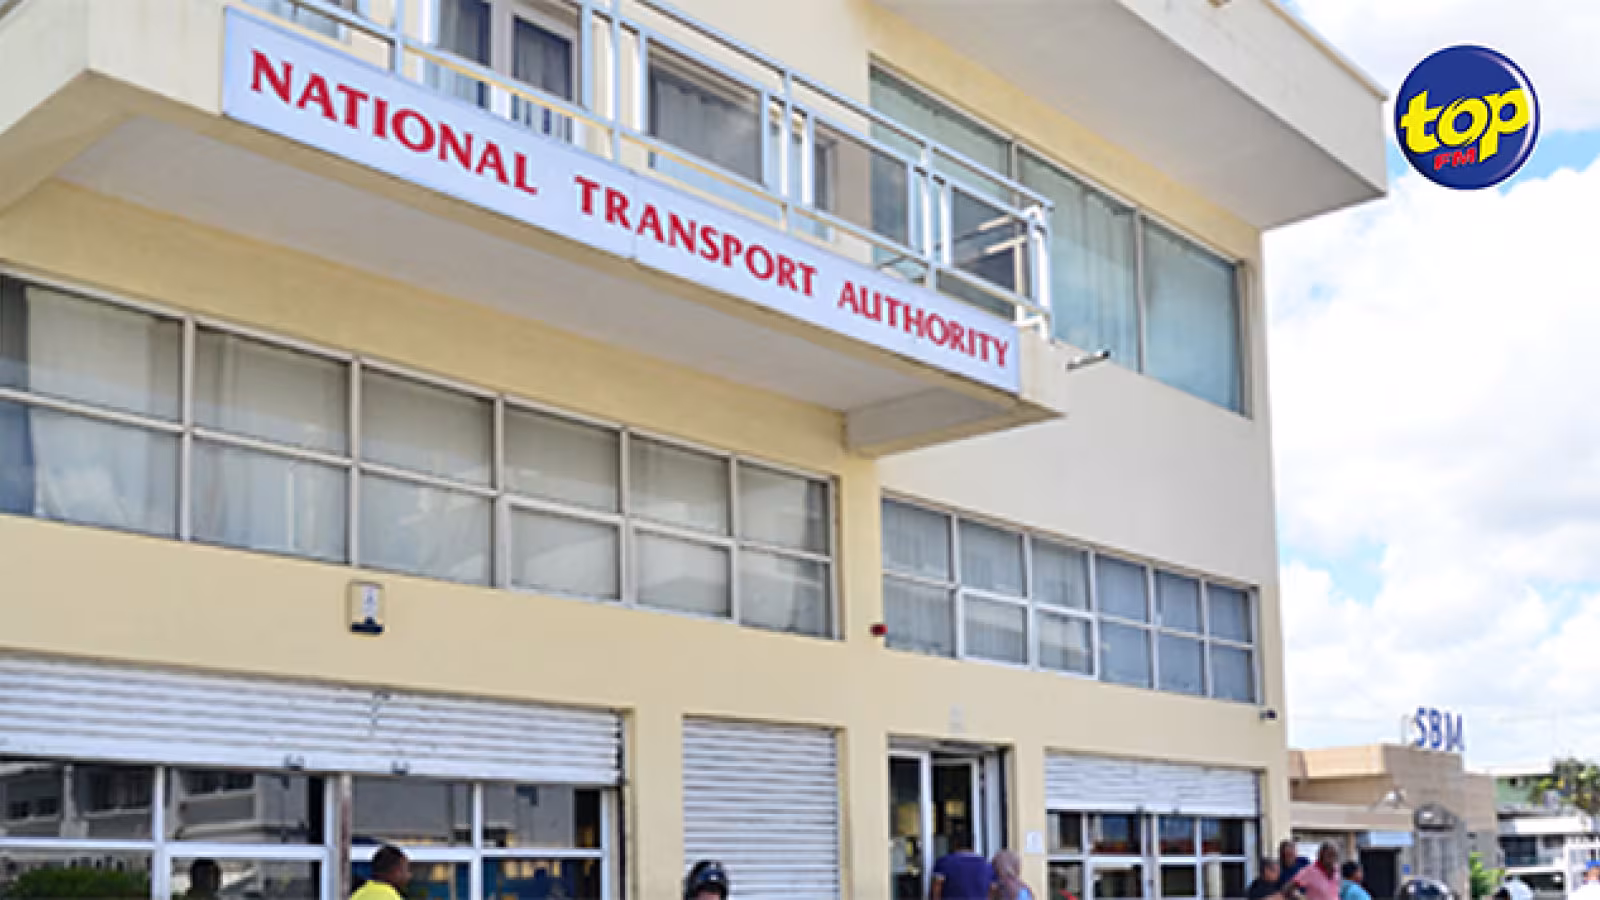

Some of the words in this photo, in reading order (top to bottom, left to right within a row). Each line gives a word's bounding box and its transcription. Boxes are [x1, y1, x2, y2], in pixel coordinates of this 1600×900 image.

[250, 48, 539, 196] NATIONAL
[574, 174, 819, 298] TRANSPORT
[837, 280, 1010, 369] AUTHORITY
